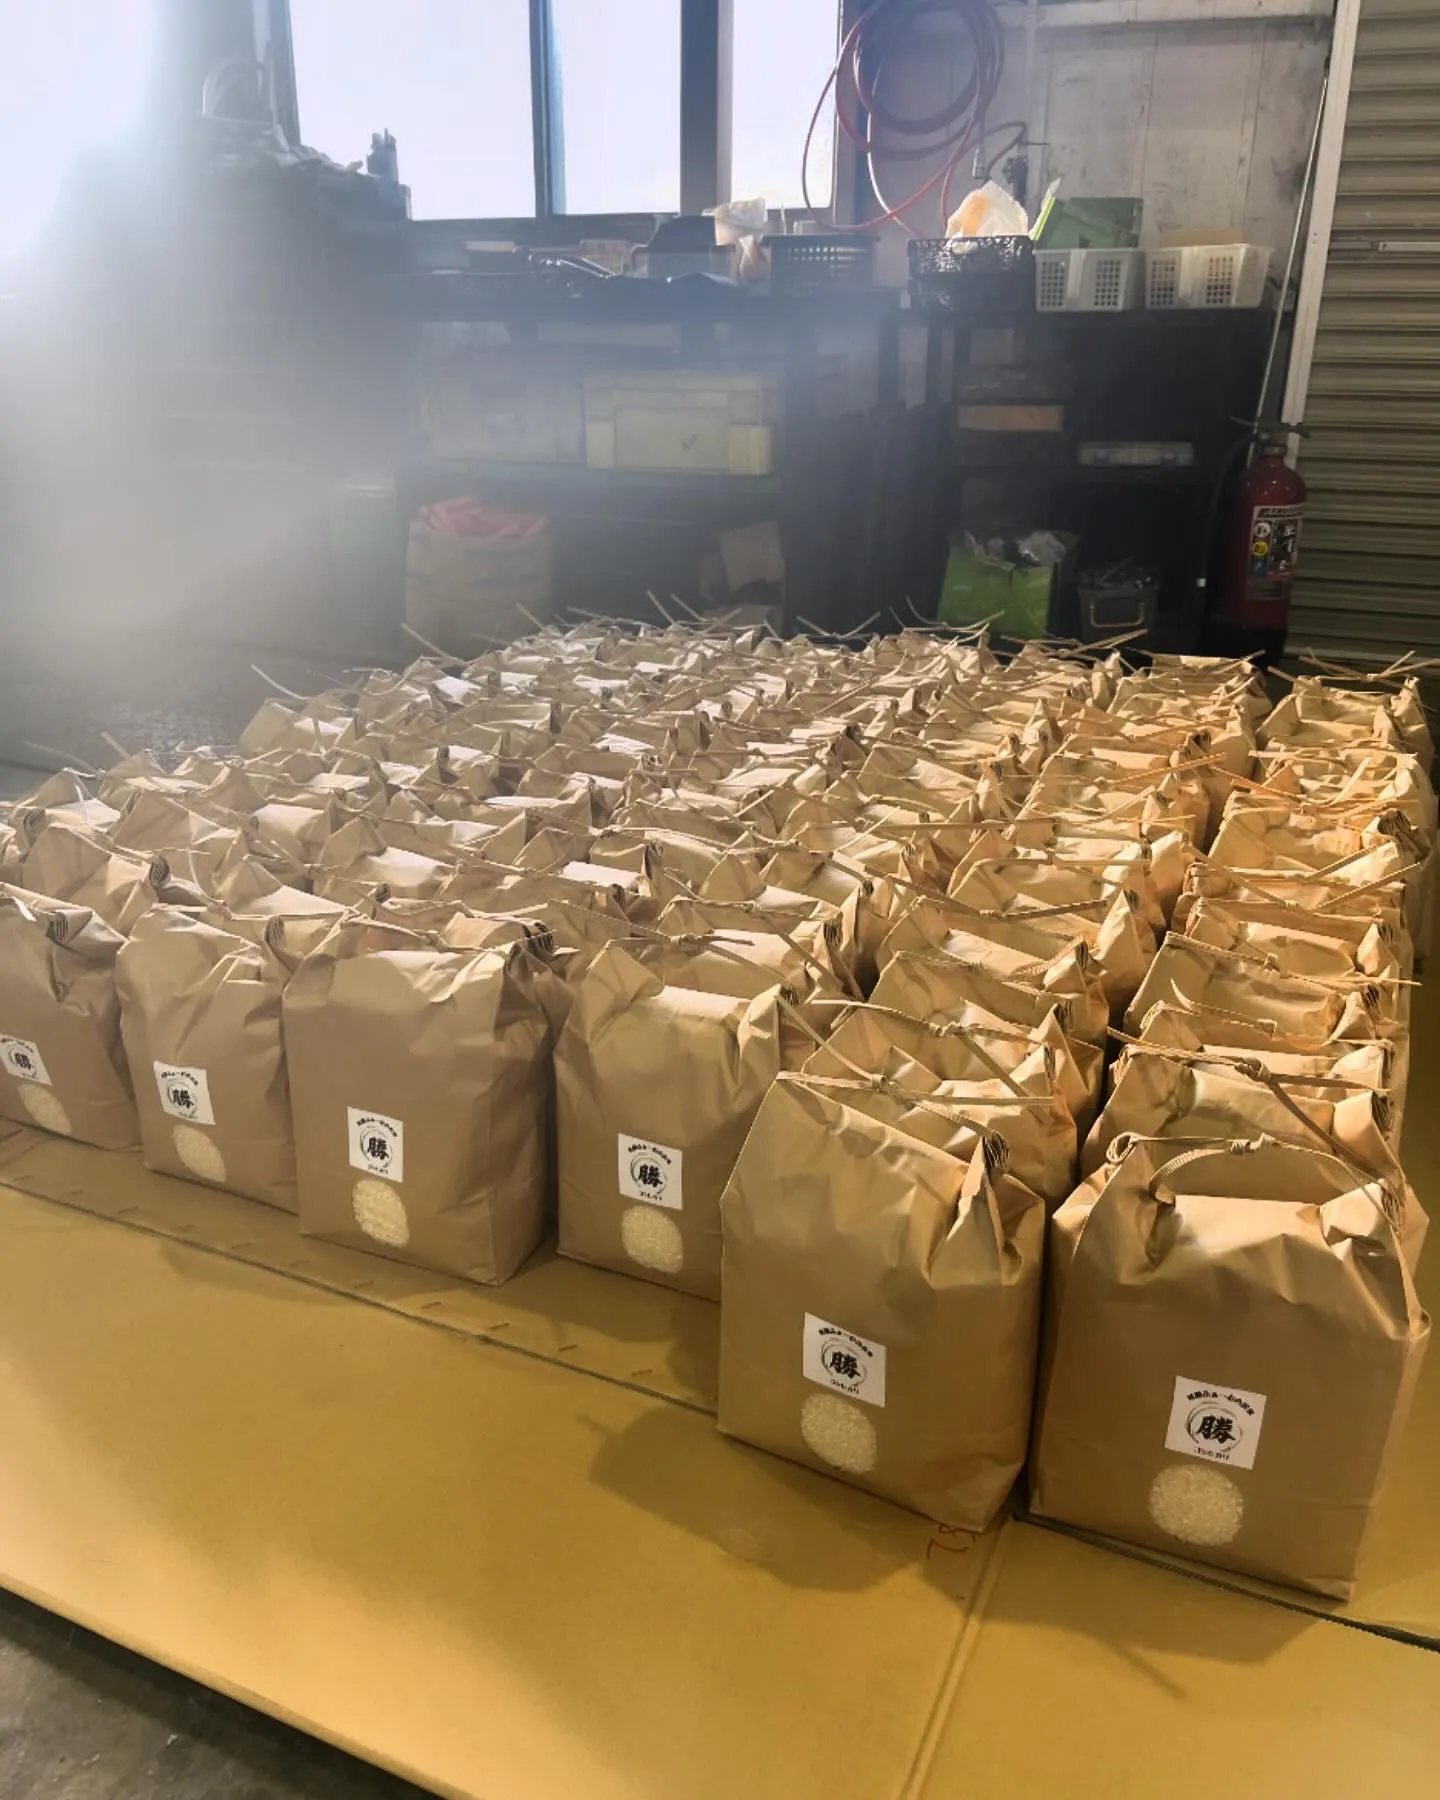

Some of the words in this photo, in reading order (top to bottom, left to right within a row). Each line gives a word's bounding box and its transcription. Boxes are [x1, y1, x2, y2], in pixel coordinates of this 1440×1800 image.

[172, 1089, 195, 1109] 勝
[367, 1137, 389, 1160] 勝
[638, 1164, 663, 1188] 勝
[829, 1351, 861, 1379] 勝
[1195, 1415, 1236, 1444] 勝
